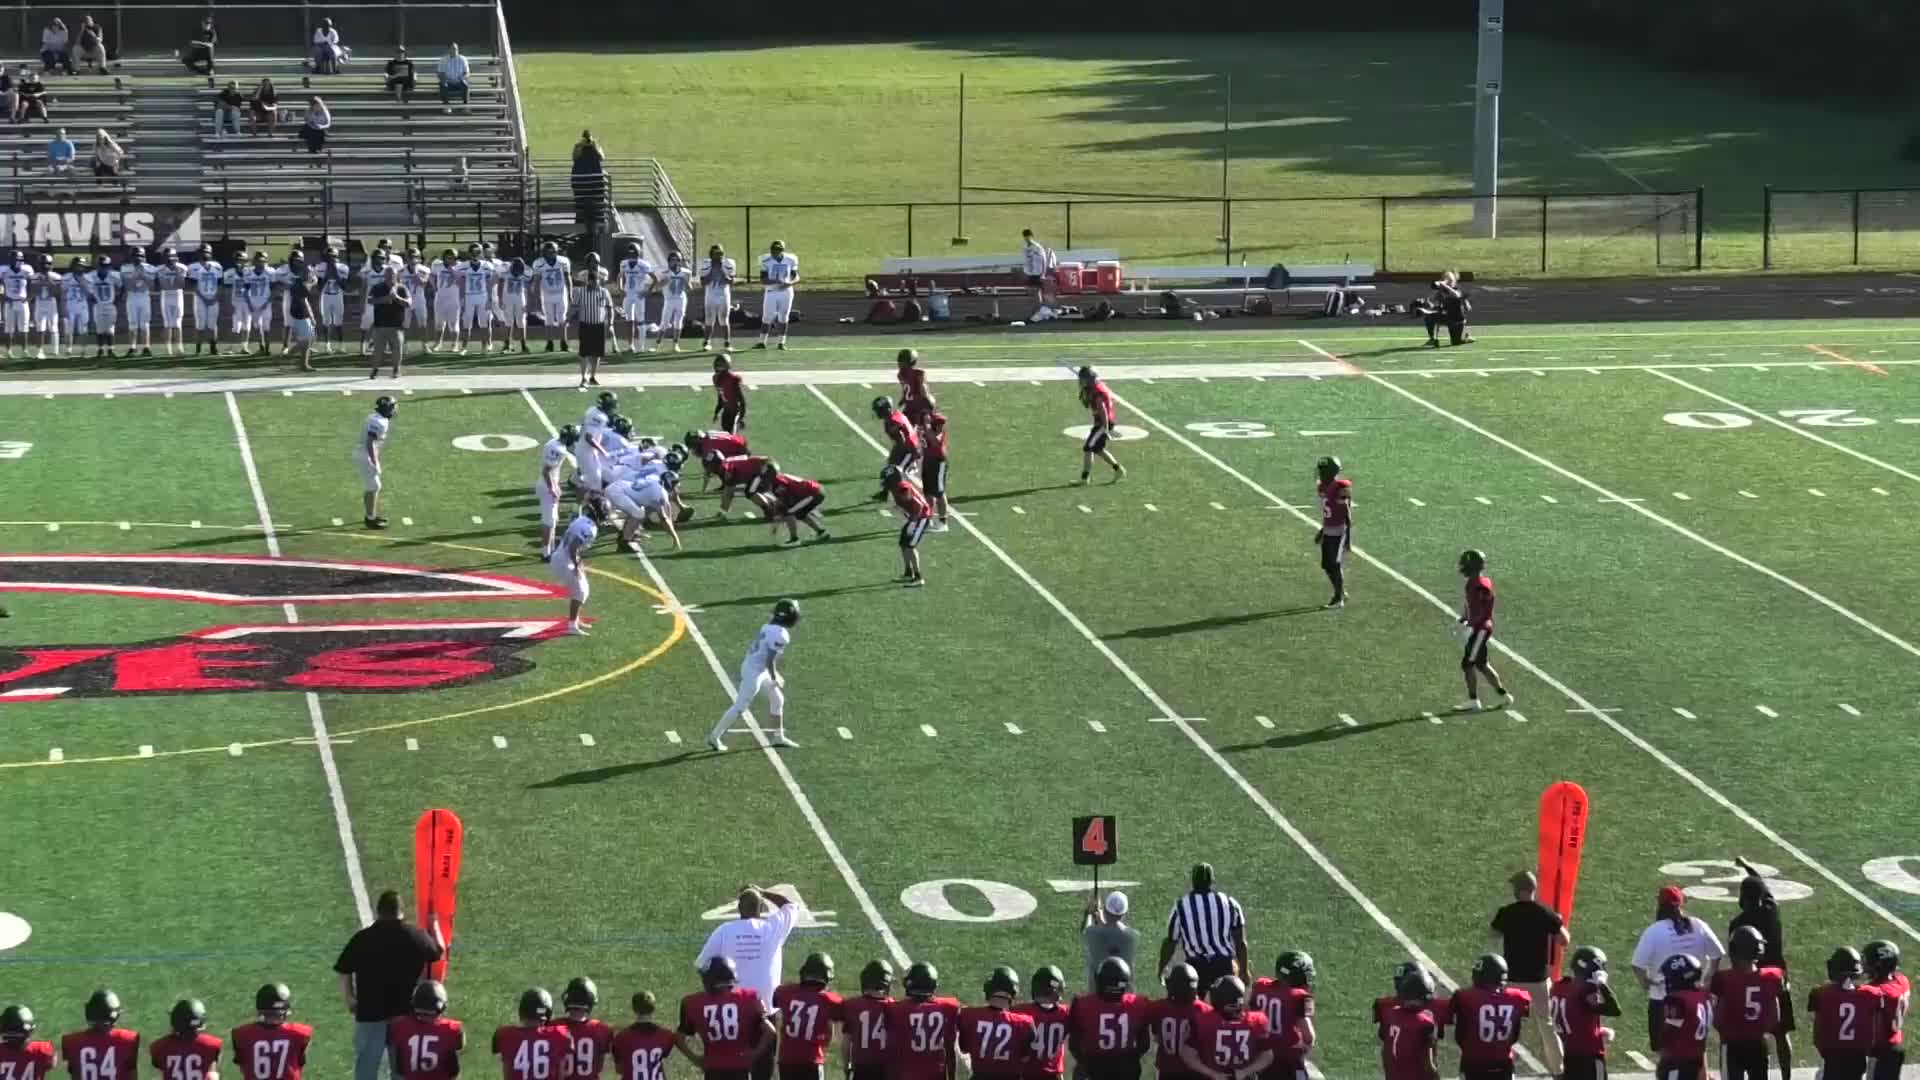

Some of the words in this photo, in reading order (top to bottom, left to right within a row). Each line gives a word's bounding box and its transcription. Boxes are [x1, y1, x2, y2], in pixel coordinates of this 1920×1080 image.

[1083, 817, 1108, 854] 4
[704, 1003, 739, 1041] 38
[786, 1000, 819, 1040] 31
[1745, 986, 1761, 1020] 5
[1838, 1002, 1856, 1040] 2
[858, 1011, 888, 1050] 14
[909, 1011, 945, 1051] 32
[976, 1020, 1013, 1060] 72
[1033, 1022, 1064, 1058] 40
[1099, 1013, 1128, 1050] 51
[1479, 1004, 1513, 1043] 63
[80, 1046, 117, 1080] 64
[253, 1039, 290, 1080] 67
[408, 1035, 440, 1072] 15
[513, 1039, 550, 1080] 46
[1216, 1029, 1249, 1065] 53
